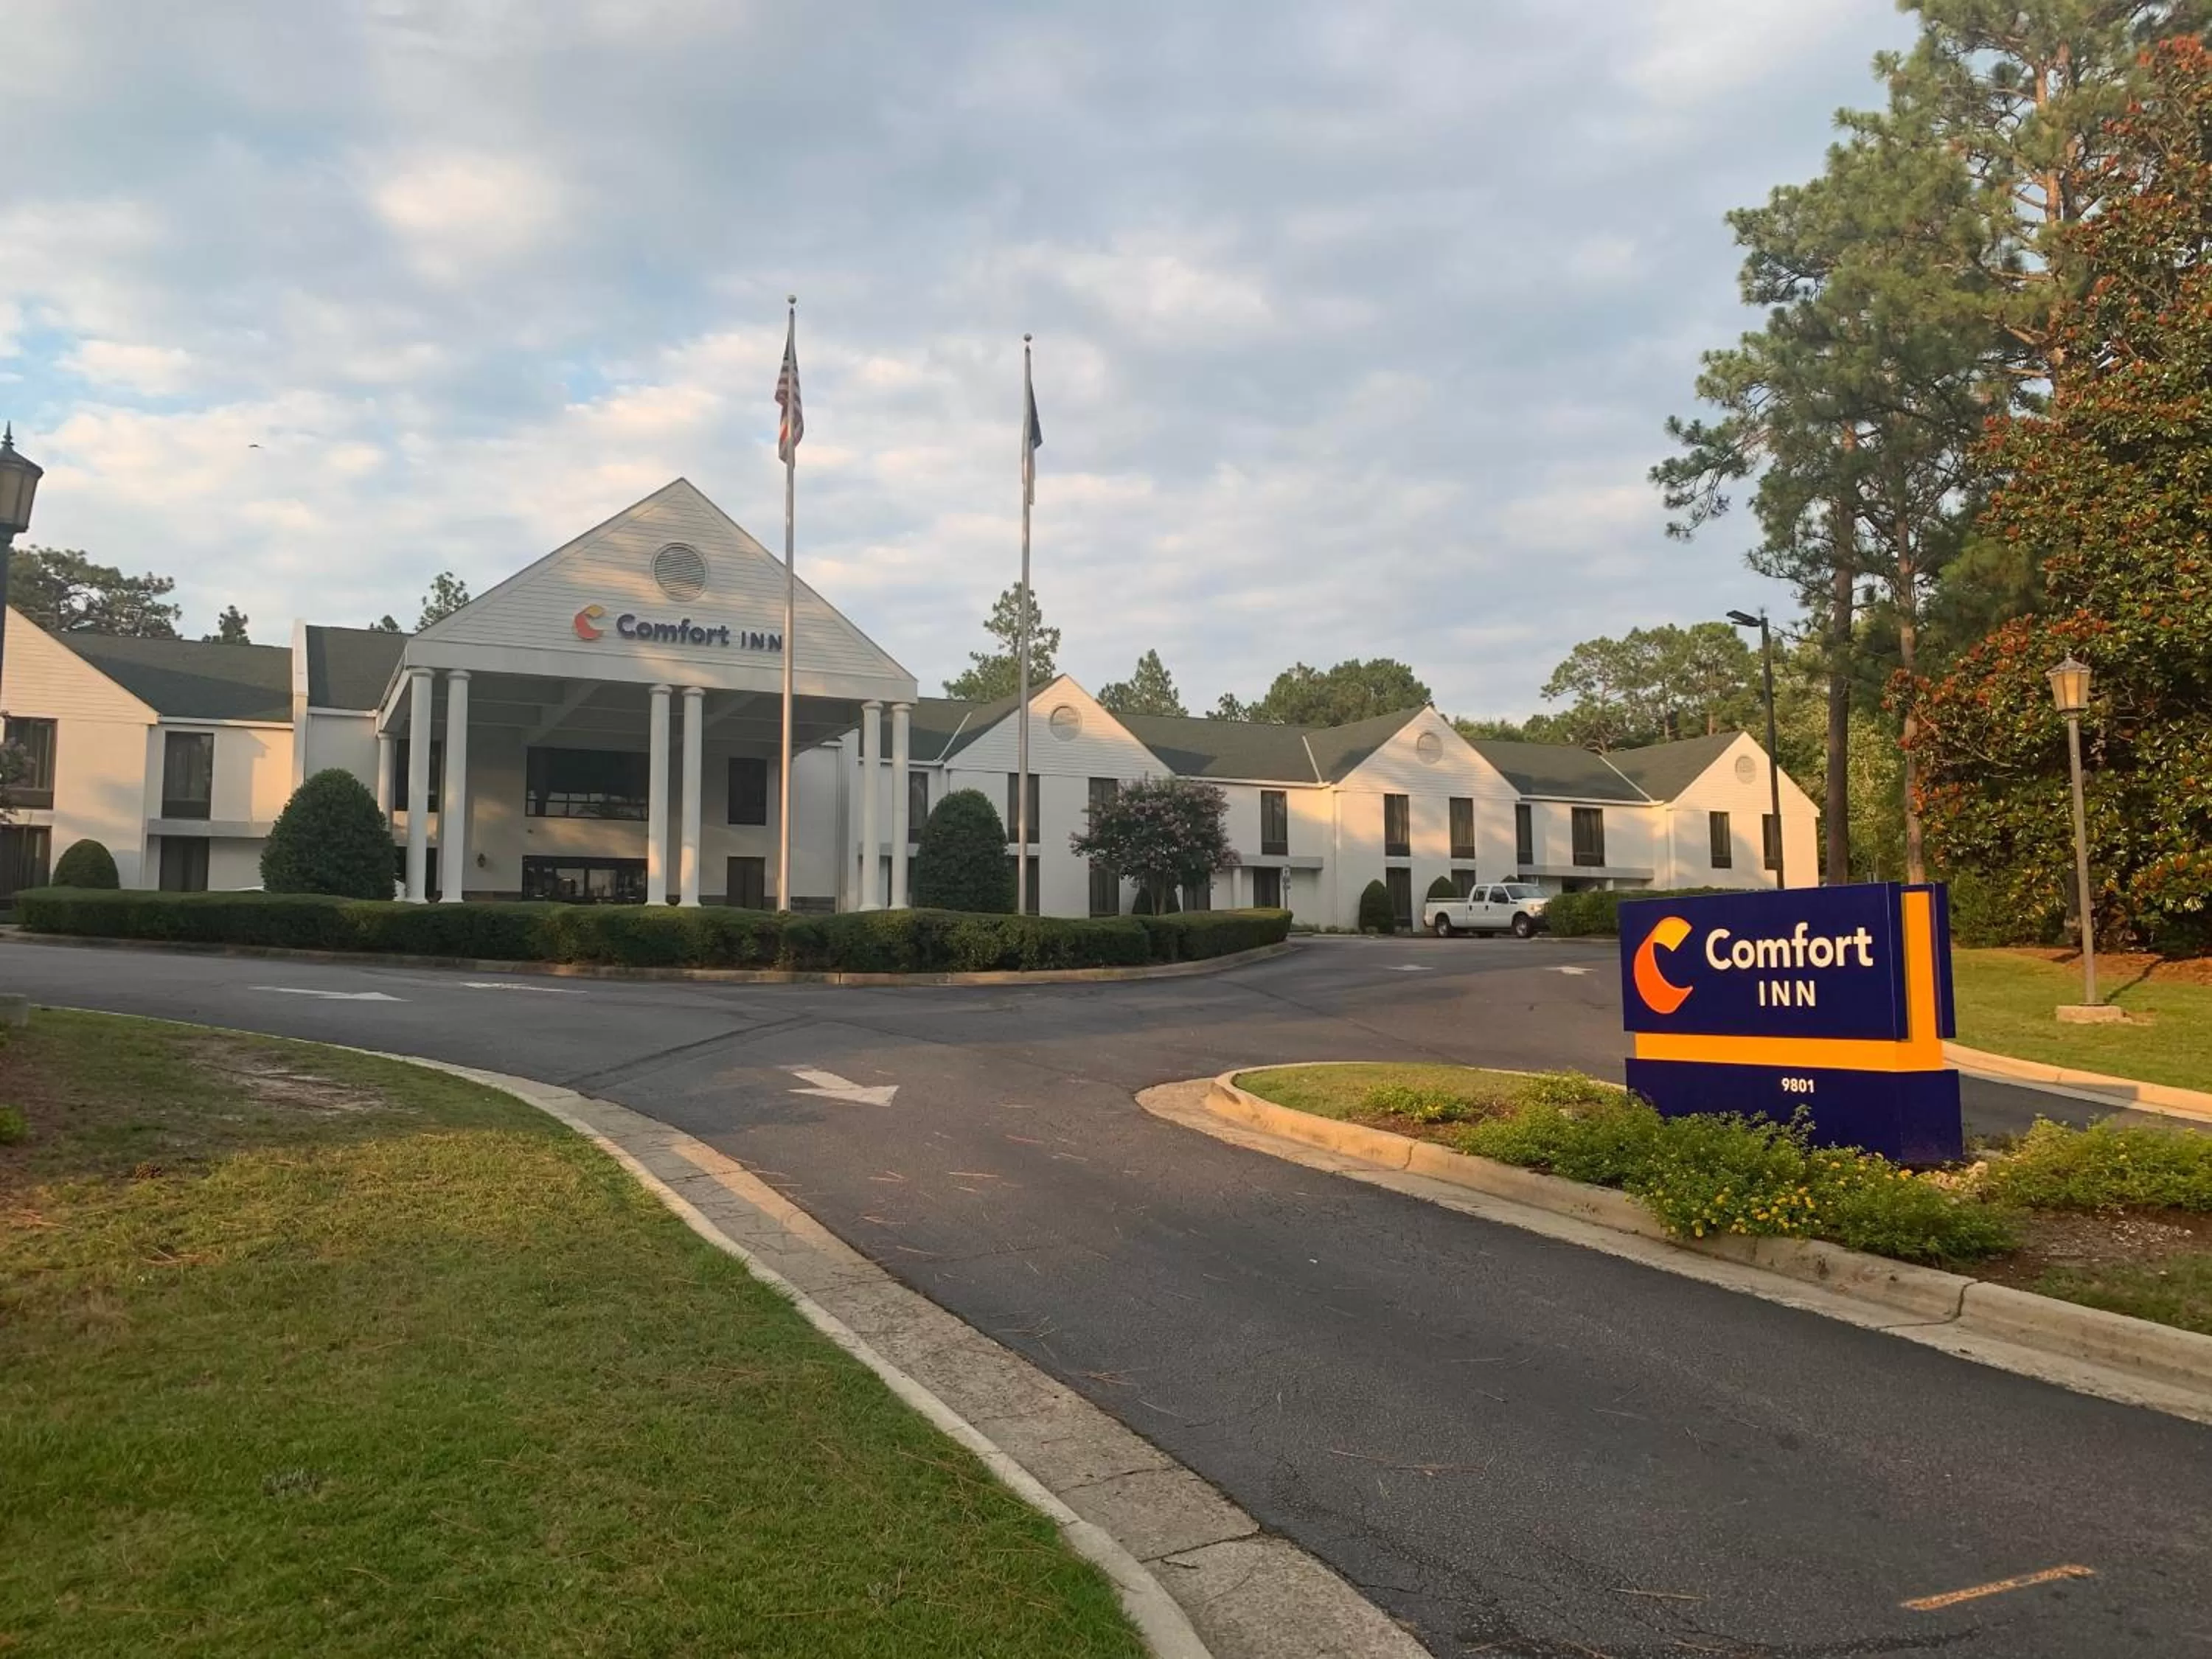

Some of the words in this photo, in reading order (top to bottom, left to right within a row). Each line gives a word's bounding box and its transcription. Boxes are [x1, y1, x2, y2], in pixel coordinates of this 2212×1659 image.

[616, 613, 730, 647] Comfort
[740, 630, 783, 652] INN
[1705, 922, 1874, 970] Comfort
[1759, 980, 1816, 1007] INN
[1781, 1077, 1815, 1093] 9801
